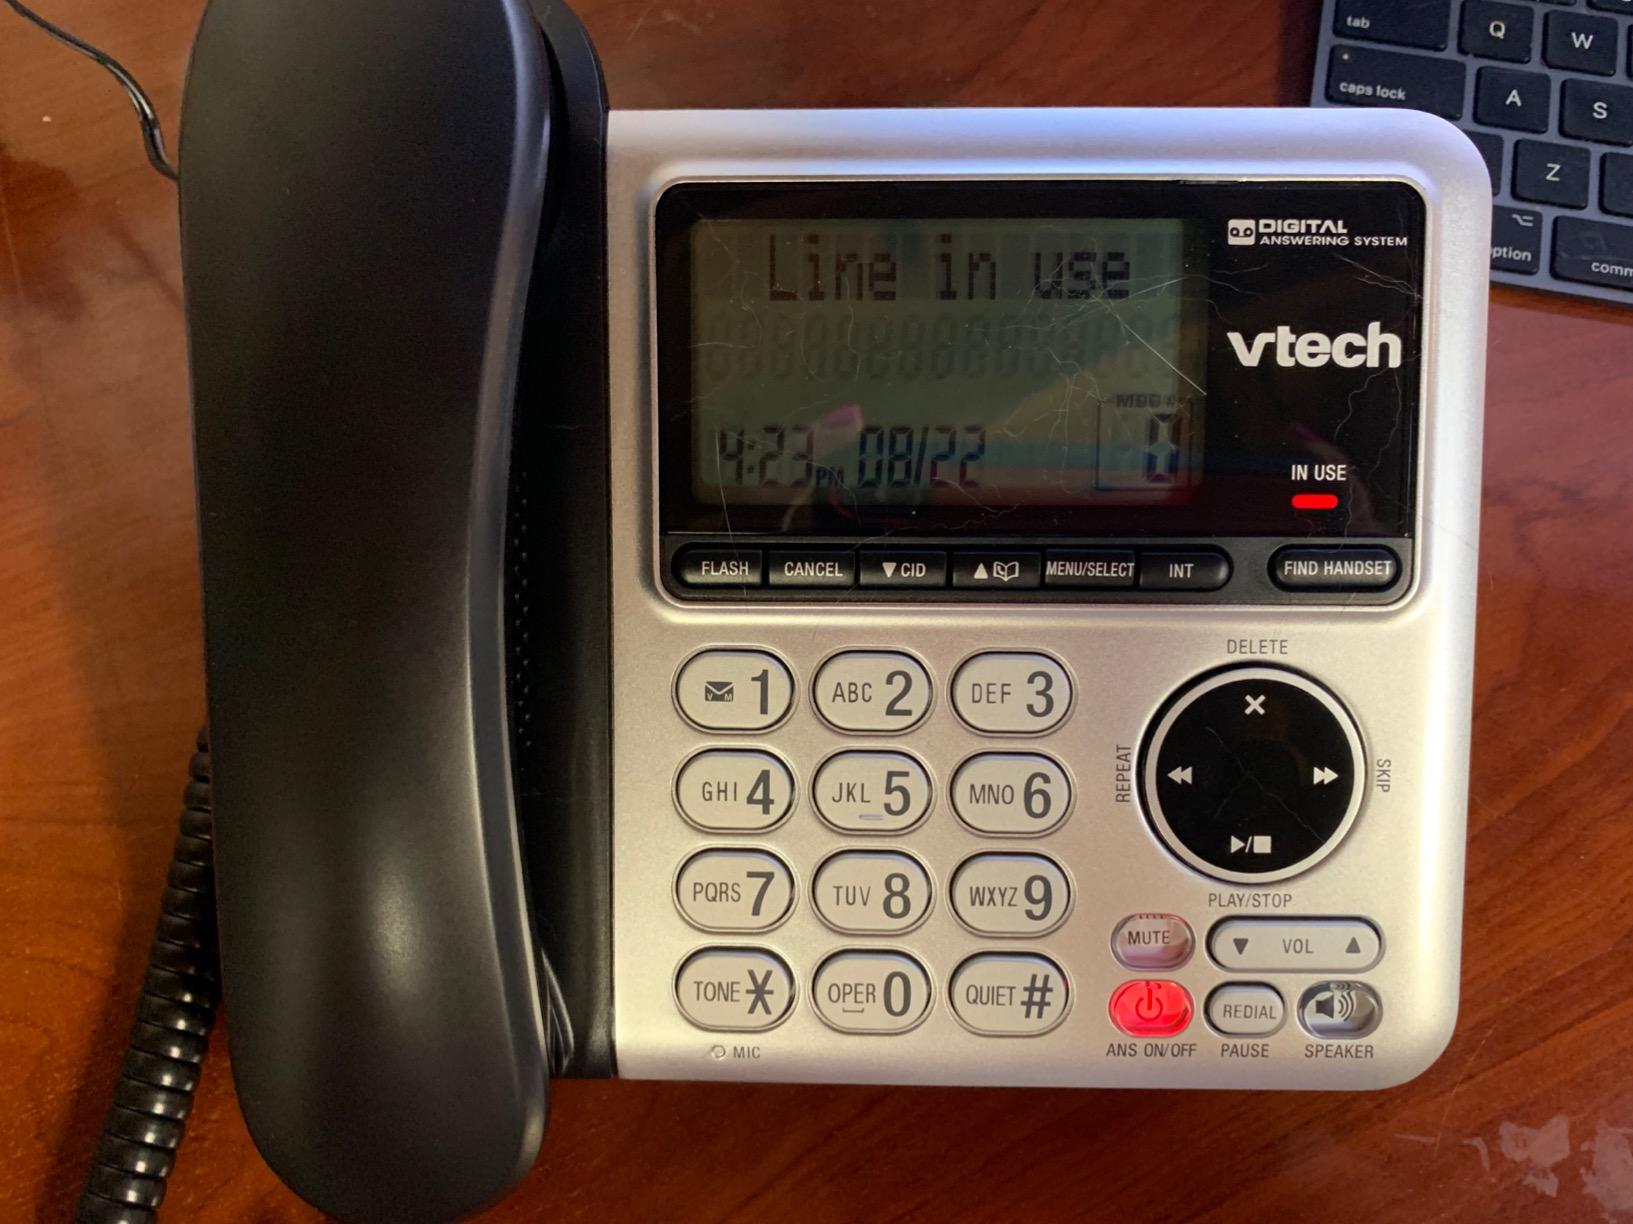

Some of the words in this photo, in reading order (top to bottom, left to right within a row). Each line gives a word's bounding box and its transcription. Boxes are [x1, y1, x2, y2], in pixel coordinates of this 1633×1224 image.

[1347, 16, 1370, 29] tab
[1489, 21, 1507, 39] Q
[1571, 31, 1594, 49] W
[1339, 81, 1373, 97] caps
[1375, 85, 1406, 100] lock
[1505, 89, 1522, 107] A
[1592, 101, 1608, 119] S
[1545, 163, 1561, 181] Z
[1258, 219, 1348, 234] DIGITAL
[1259, 235, 1350, 246] ANSWERING
[1354, 236, 1408, 246] SYSTEM
[1490, 246, 1532, 262] ption
[769, 233, 897, 300] Line
[937, 233, 996, 300] in
[1033, 251, 1130, 300] use
[1227, 322, 1401, 368] vtech
[719, 425, 815, 488] 4:23
[857, 425, 987, 488] 08/22
[1291, 464, 1308, 481] IN
[1314, 464, 1347, 481] USE
[702, 561, 749, 576] FLASH
[784, 562, 843, 577] CANCEL
[901, 562, 926, 577] CID
[1045, 561, 1135, 578] MENU/SELECT
[1168, 563, 1194, 579] INT
[1284, 561, 1318, 576] FIND
[1323, 561, 1392, 576] HANDSET
[1226, 639, 1289, 655] DELETE
[751, 669, 768, 715] 1
[832, 682, 872, 703] ABC
[885, 670, 913, 716] 2
[971, 683, 1012, 704] DEF
[1026, 671, 1054, 717] 3
[1116, 744, 1132, 803] REPEAT
[1376, 758, 1391, 793] SKIP
[701, 781, 738, 802] GHI
[746, 769, 775, 815] 4
[832, 782, 871, 804] JKL
[883, 771, 911, 816] 5
[969, 783, 1015, 805] MNO
[1024, 772, 1052, 818] 6
[692, 882, 741, 903] PQRS
[746, 871, 775, 917] 7
[833, 885, 871, 907] TUV
[882, 873, 911, 919] 8
[969, 886, 1018, 907] WXYZ
[1024, 875, 1053, 921] 9
[1208, 893, 1293, 908] PLAY/STOP
[1127, 930, 1170, 945] MUTE
[1282, 938, 1314, 954] VOL
[694, 981, 740, 1003] TONE
[827, 983, 876, 1004] OPER
[883, 971, 912, 1017] 0
[965, 984, 1017, 1006] QUIET
[1223, 1004, 1277, 1020] REDIAL
[733, 1046, 761, 1059] MIC
[1106, 1043, 1137, 1057] ANS
[1144, 1043, 1197, 1058] ON/OFF
[1220, 1043, 1270, 1058] PAUSE
[1304, 1044, 1374, 1059] SPEAKER
